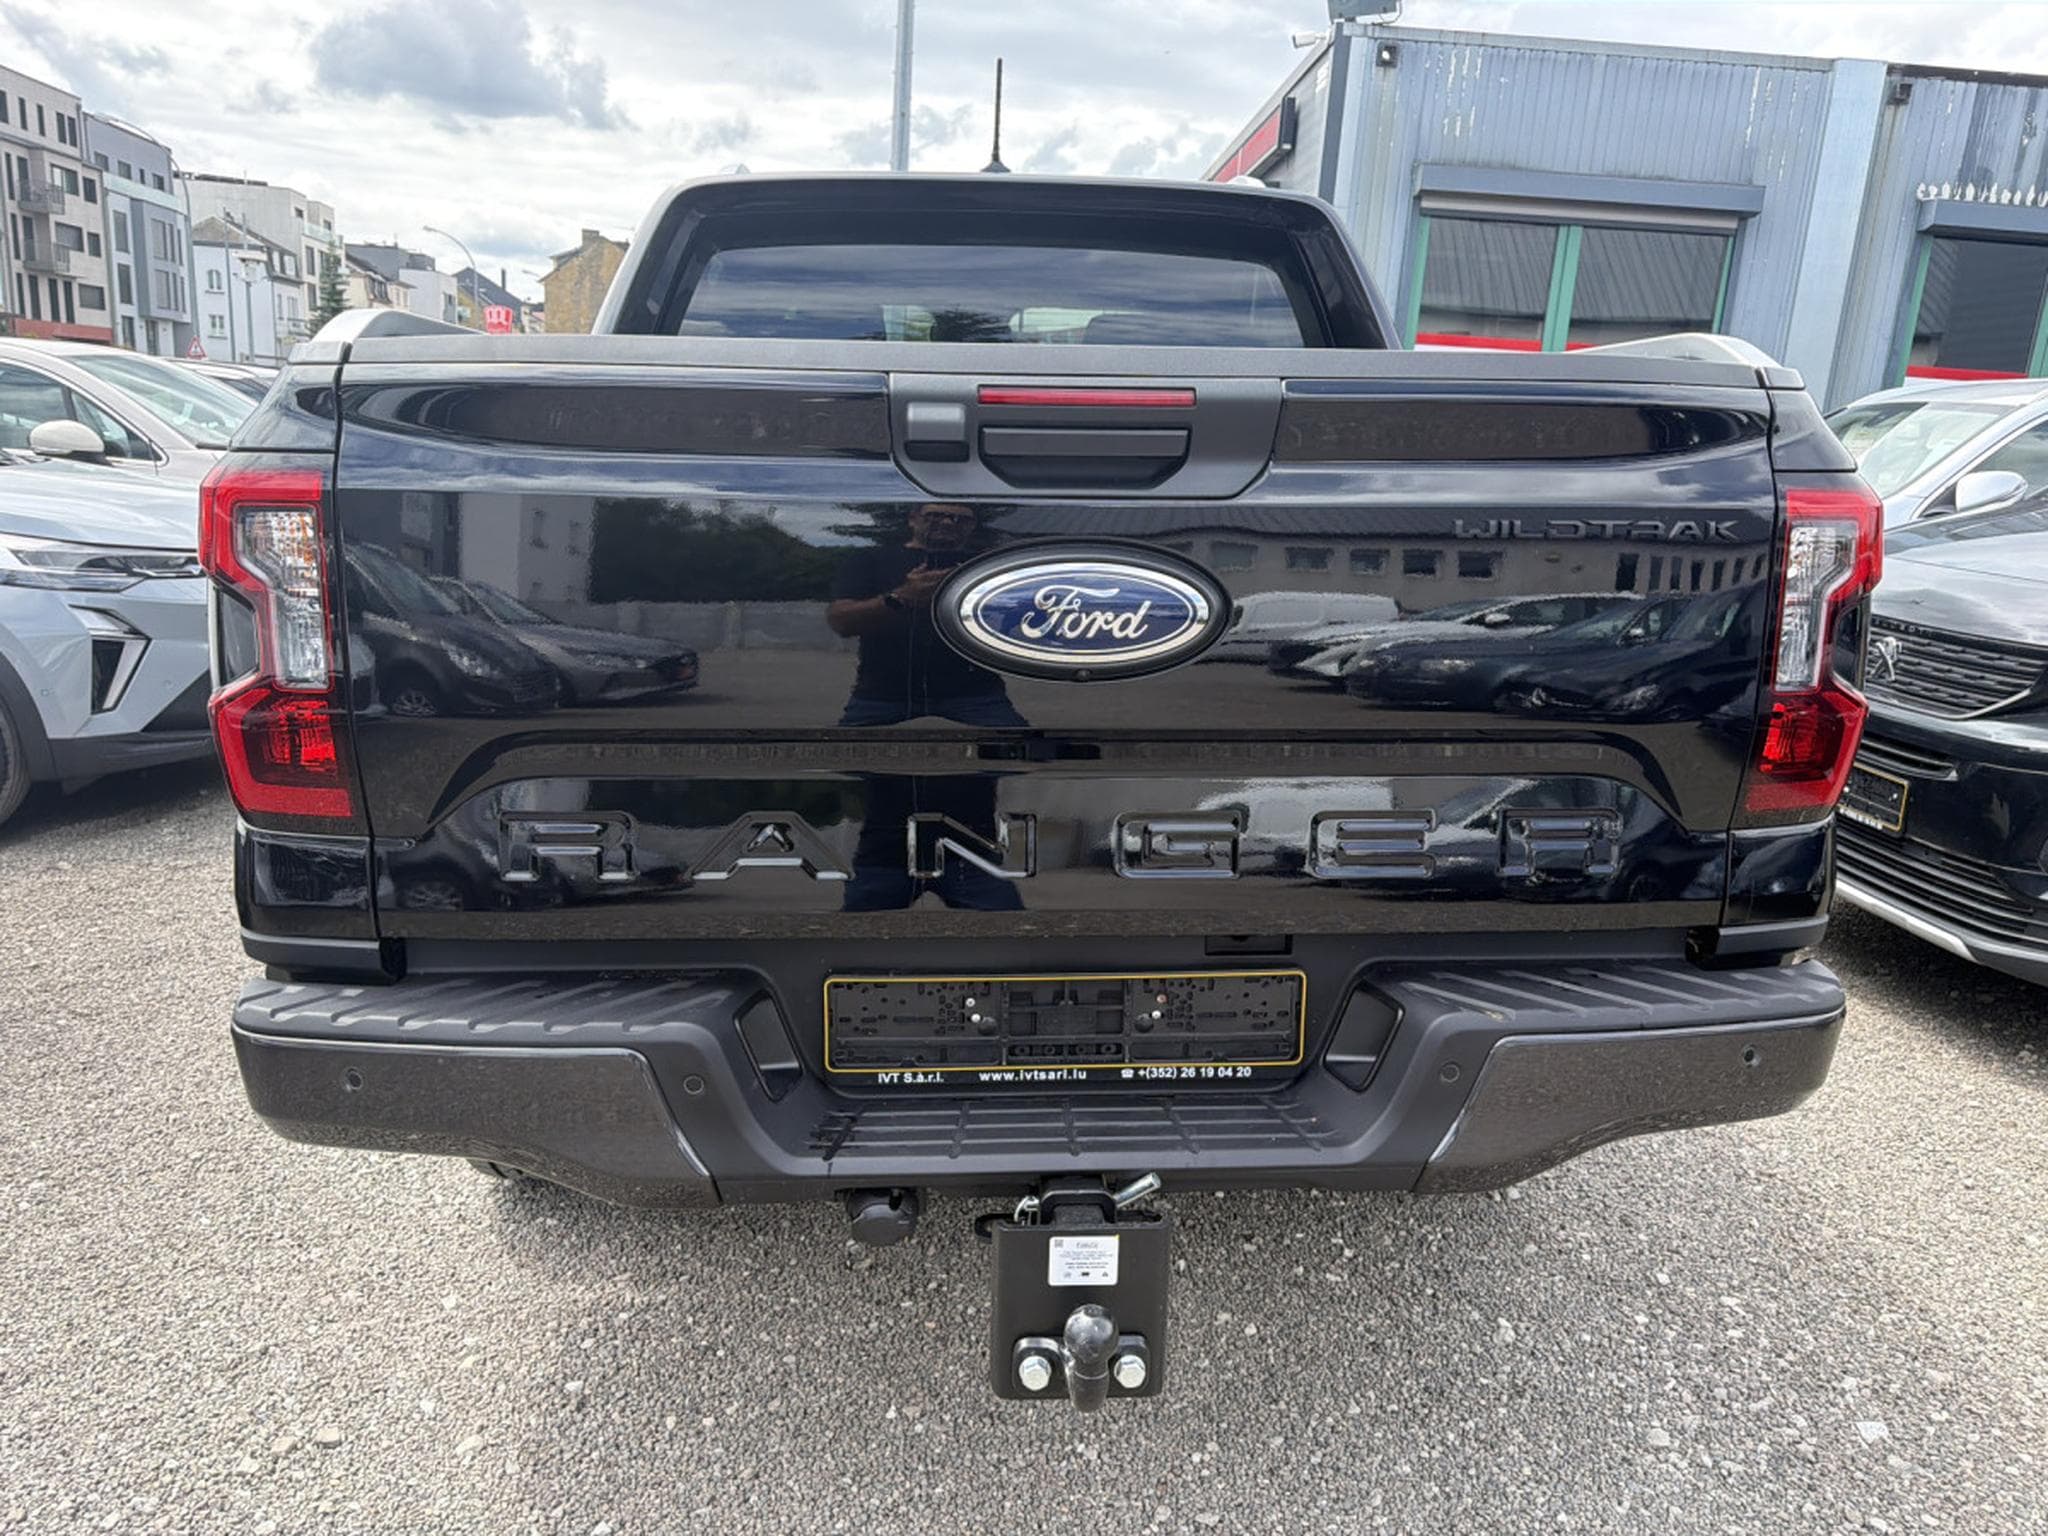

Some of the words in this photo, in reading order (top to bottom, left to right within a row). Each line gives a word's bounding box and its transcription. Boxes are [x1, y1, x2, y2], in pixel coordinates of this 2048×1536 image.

[1453, 518, 1741, 541] WILDTRAK
[1020, 584, 1152, 640] Ford
[499, 807, 1624, 883] RANGER
[877, 1073, 900, 1084] IVT
[978, 1069, 1088, 1082] www.ivtsarl.lu
[1137, 1067, 1177, 1080] +(352)
[1180, 1067, 1196, 1079] 26
[1200, 1067, 1214, 1078] 19
[1217, 1066, 1233, 1078] 04
[1236, 1066, 1252, 1078] 20
